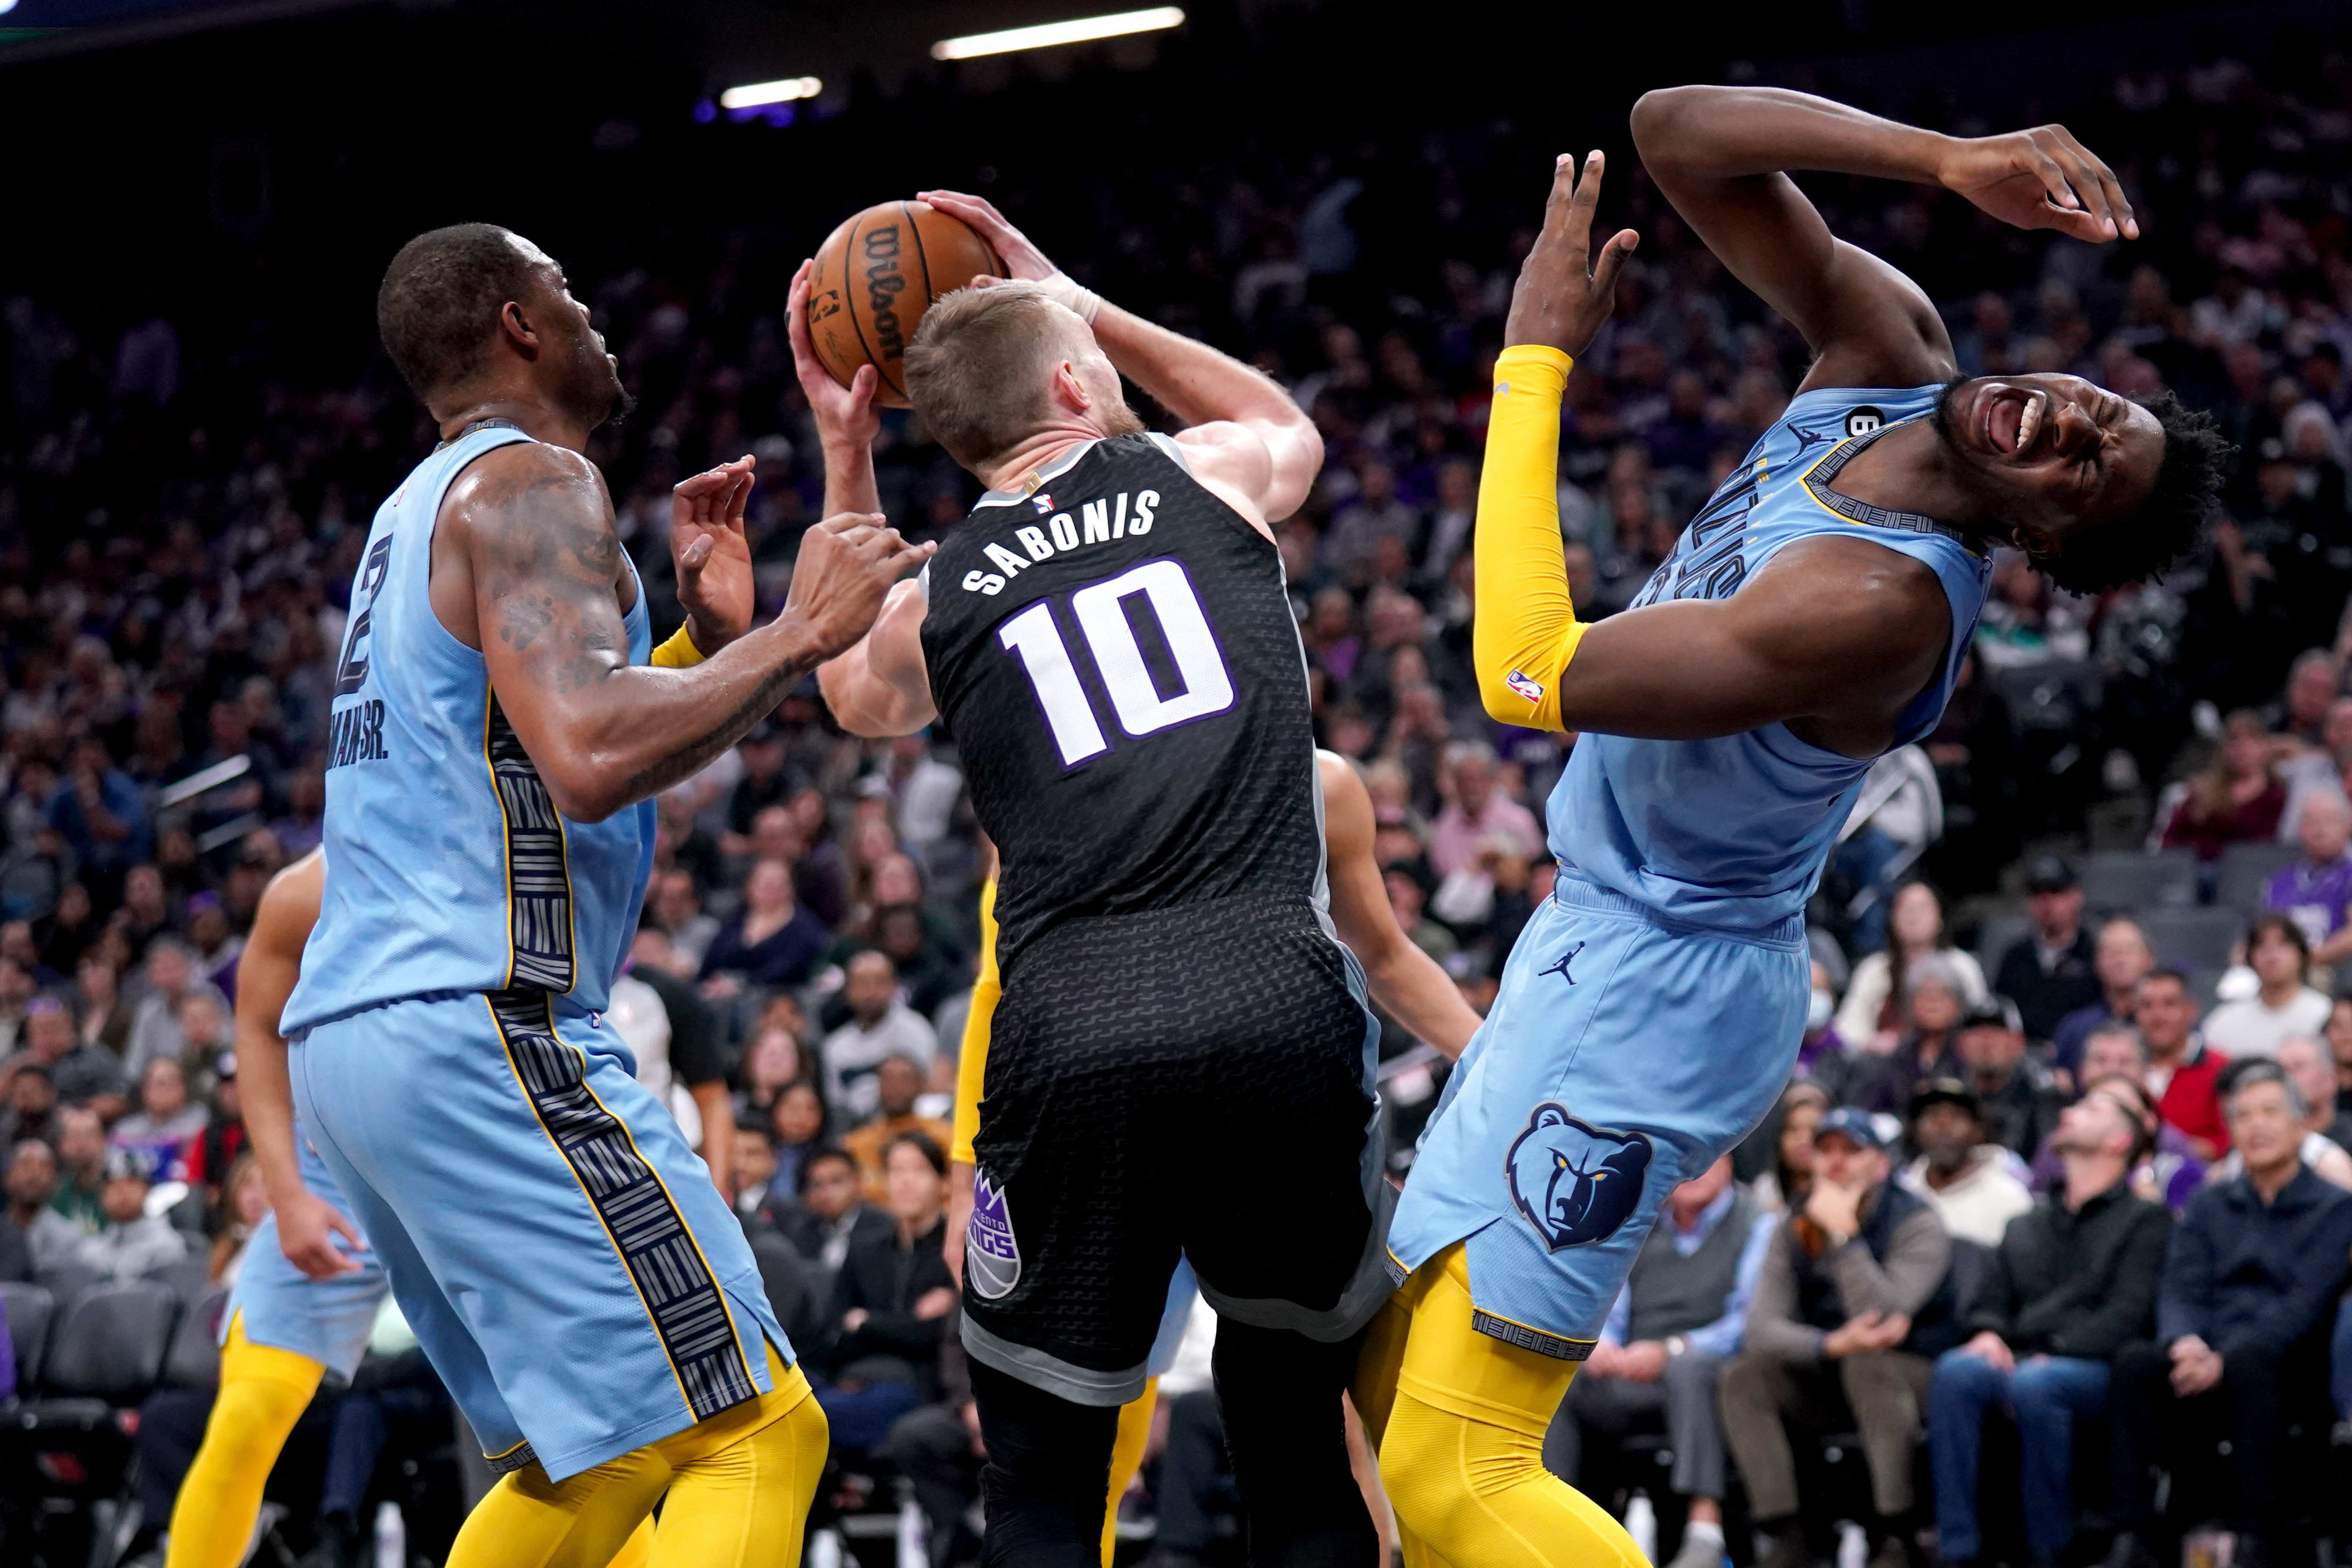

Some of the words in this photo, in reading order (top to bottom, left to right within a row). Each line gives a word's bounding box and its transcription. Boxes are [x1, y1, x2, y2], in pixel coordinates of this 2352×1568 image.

[866, 223, 905, 362] Wilson
[962, 490, 1160, 596] SABONIS
[998, 556, 1237, 771] 10
